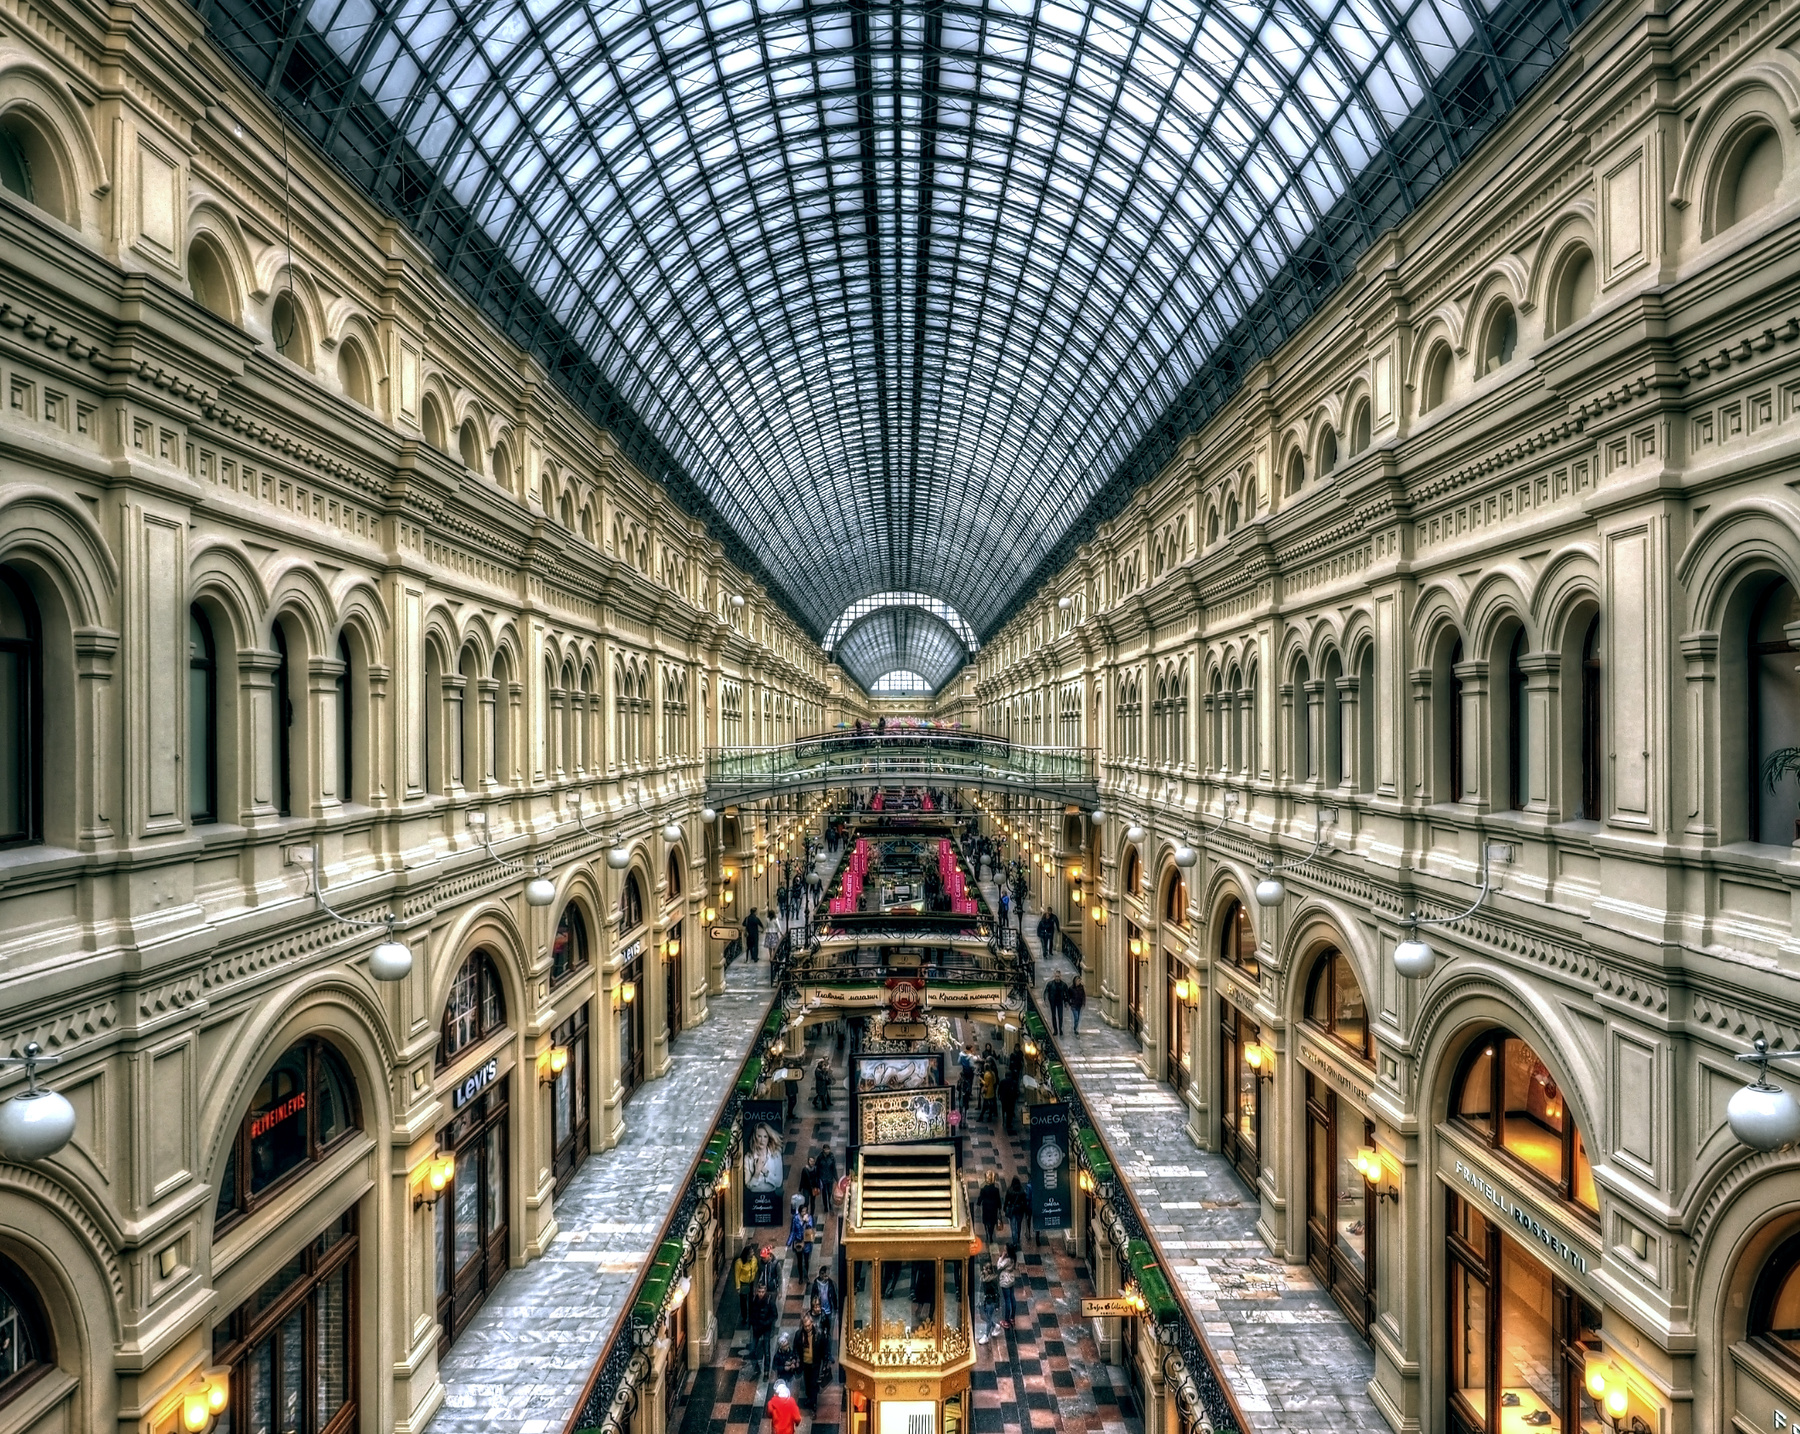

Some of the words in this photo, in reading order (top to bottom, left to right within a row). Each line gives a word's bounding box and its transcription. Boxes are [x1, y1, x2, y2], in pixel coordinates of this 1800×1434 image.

[845, 875, 853, 897] Couture
[816, 990, 845, 1000] Главный
[939, 992, 969, 1002] Красной
[970, 993, 1000, 1001] площади
[743, 1111, 782, 1121] OMEGA
[1030, 1114, 1068, 1125] OMEGA
[1455, 1160, 1514, 1216] FRATELLI
[1513, 1207, 1587, 1274] ROSSETTI
